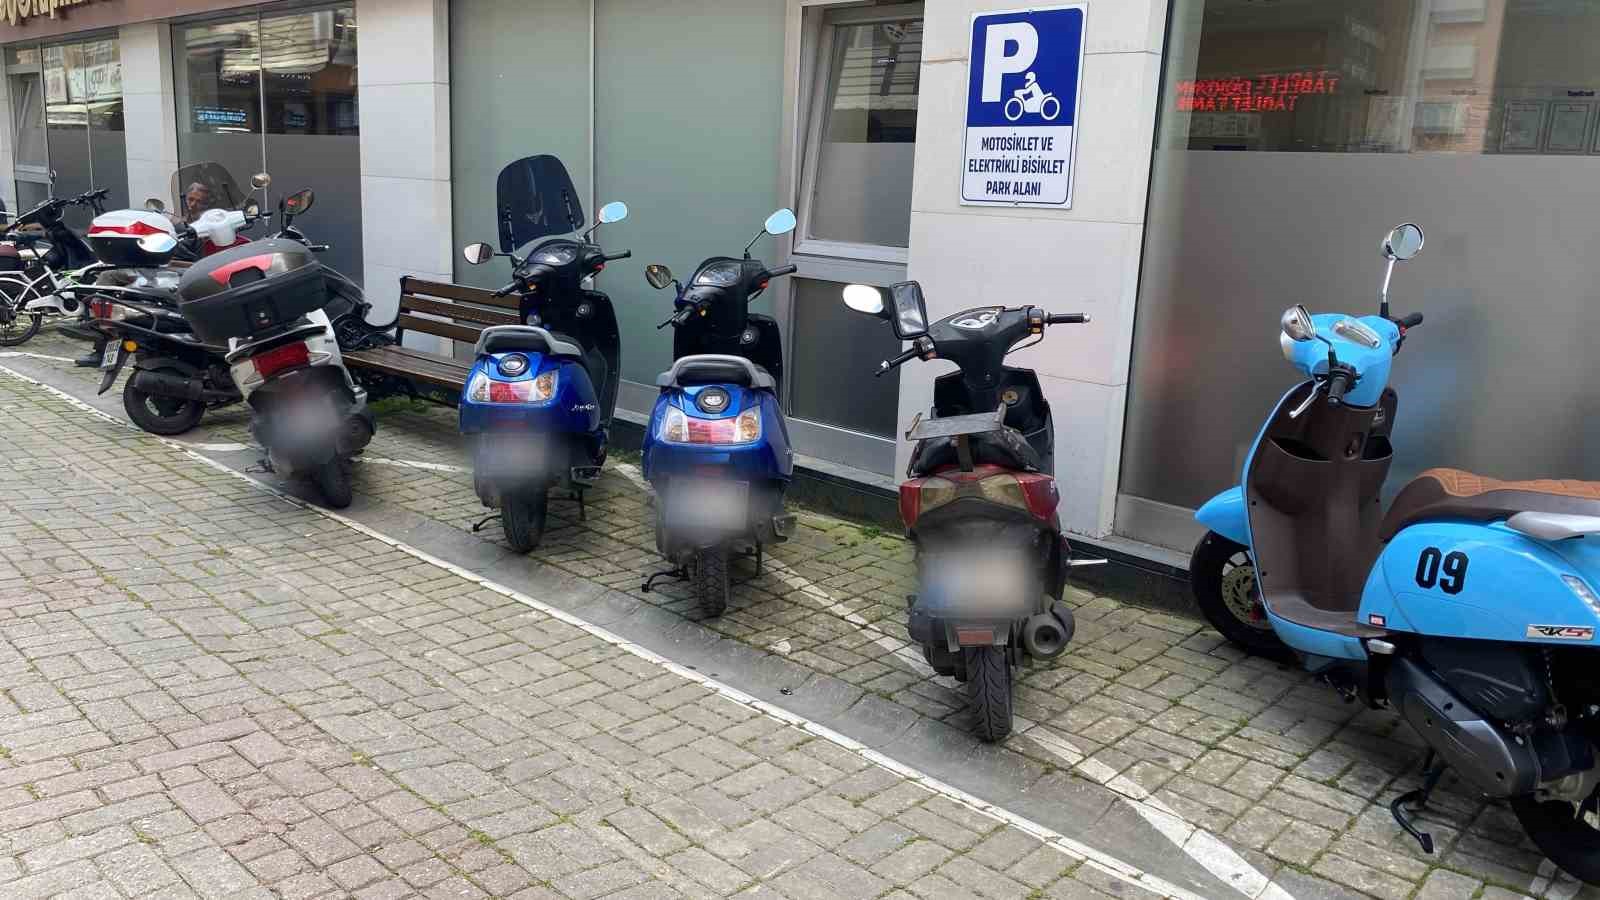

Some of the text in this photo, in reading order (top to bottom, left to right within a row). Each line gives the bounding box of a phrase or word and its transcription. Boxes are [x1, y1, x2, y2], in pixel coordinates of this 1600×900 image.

[982, 21, 1039, 103] P
[981, 133, 1054, 151] MOTOSİKLET VE
[968, 155, 1065, 174] ELEKTRİKLİ BİSİKLET
[986, 180, 1041, 196] PARK ALANI
[1415, 546, 1470, 595] 09
